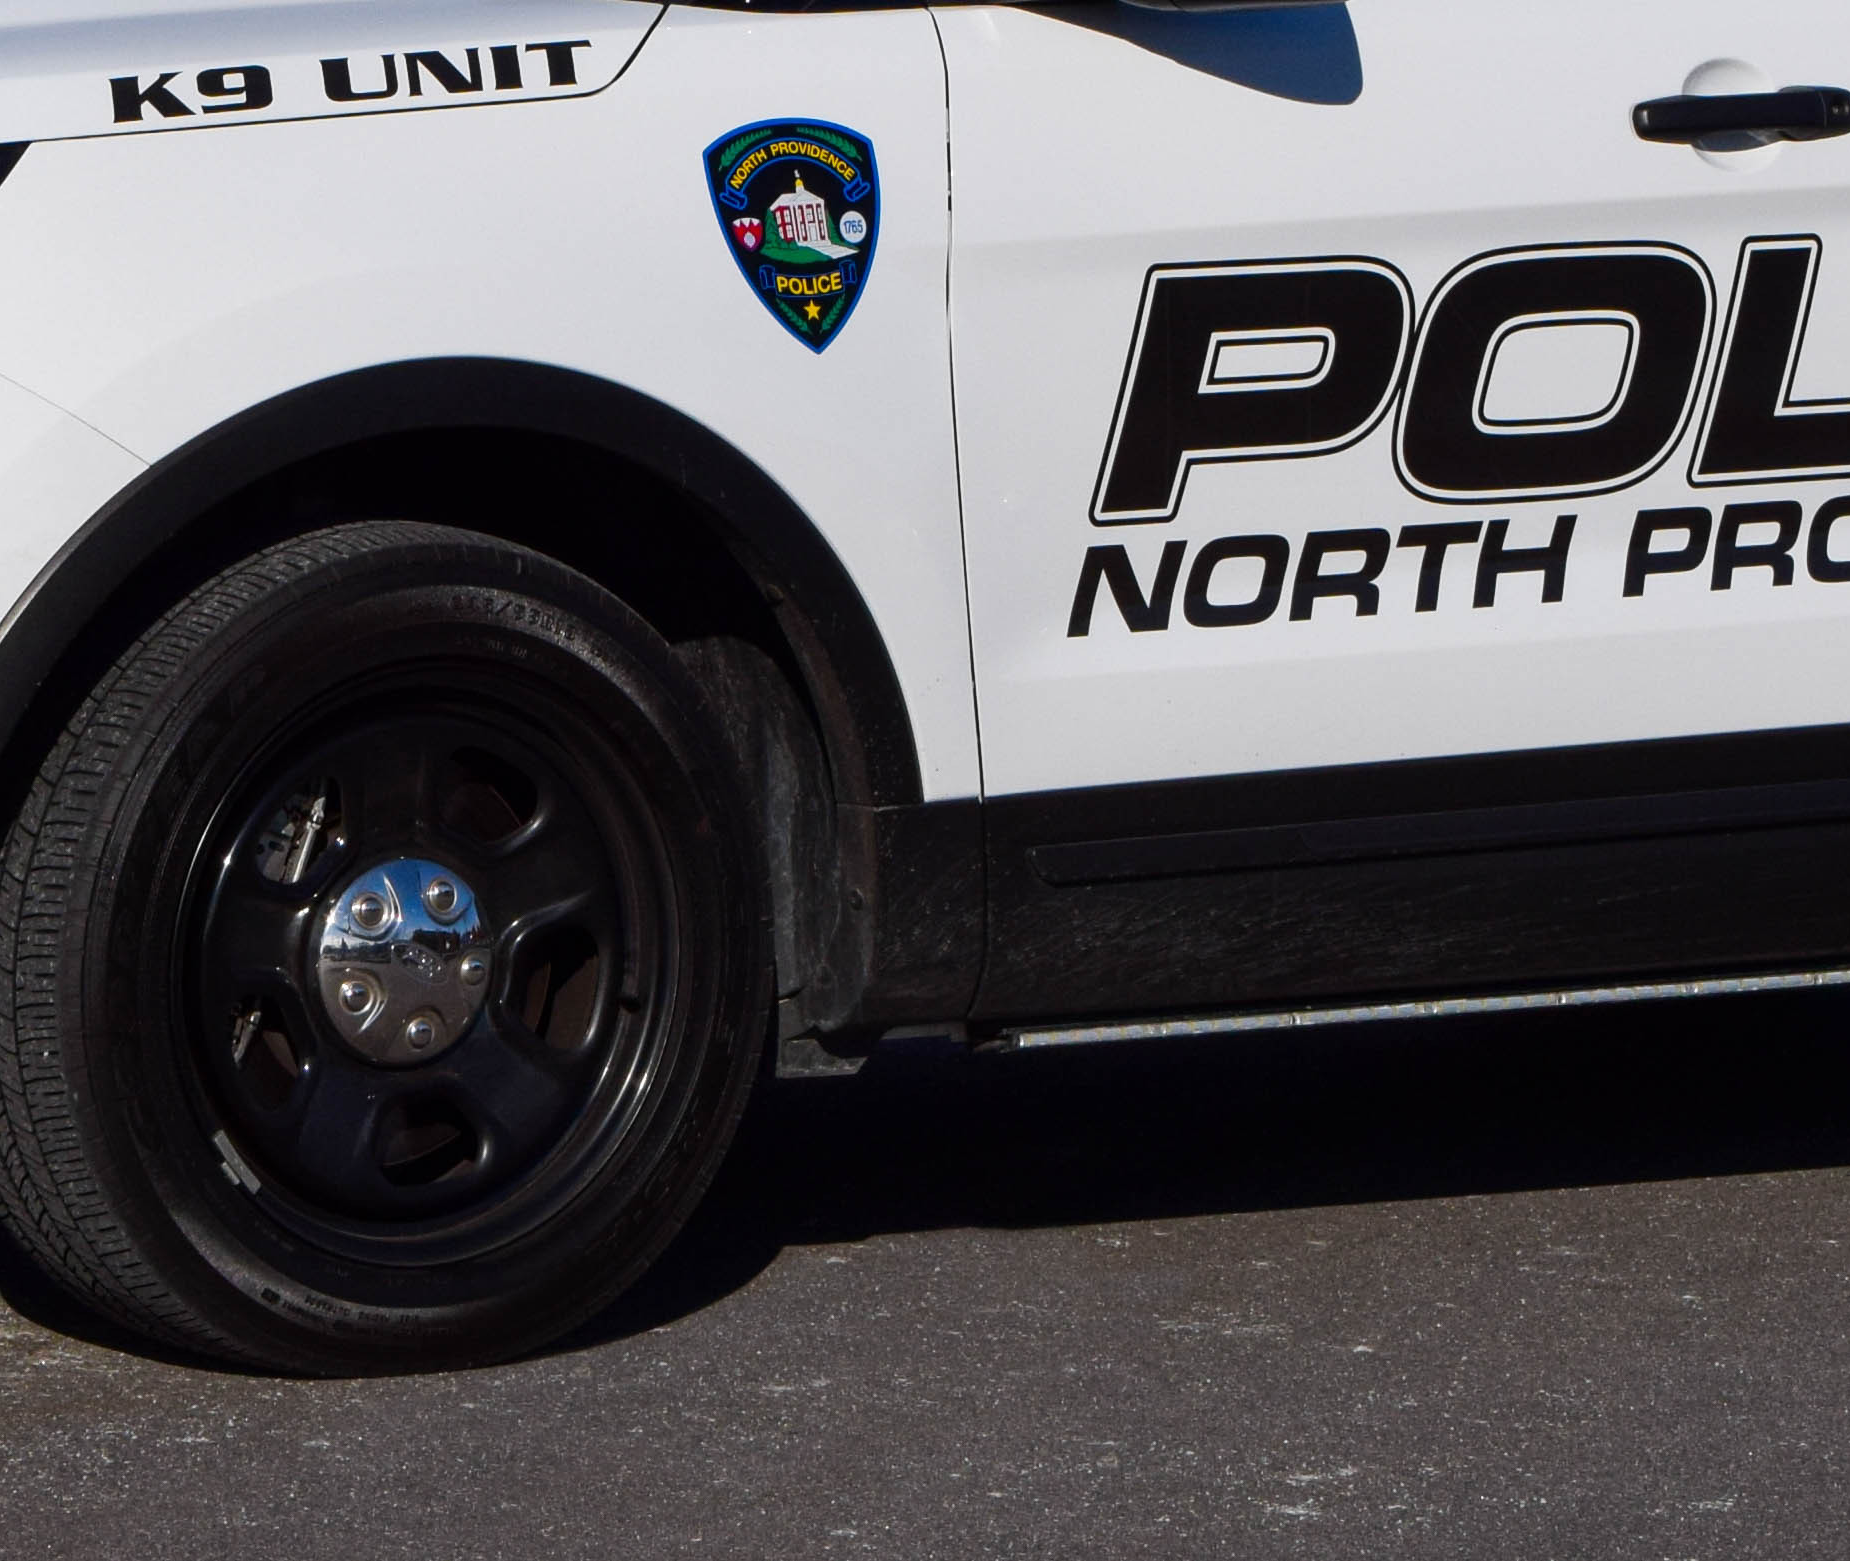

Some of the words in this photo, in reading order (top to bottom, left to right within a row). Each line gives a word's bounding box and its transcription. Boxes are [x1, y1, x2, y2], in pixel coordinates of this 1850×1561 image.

[109, 65, 273, 124] K9
[320, 40, 592, 102] UNIT
[730, 151, 768, 189] NORTH
[770, 140, 856, 182] PROVIDENCE
[776, 271, 843, 296] POLICE
[1066, 515, 1578, 637] NORTH
